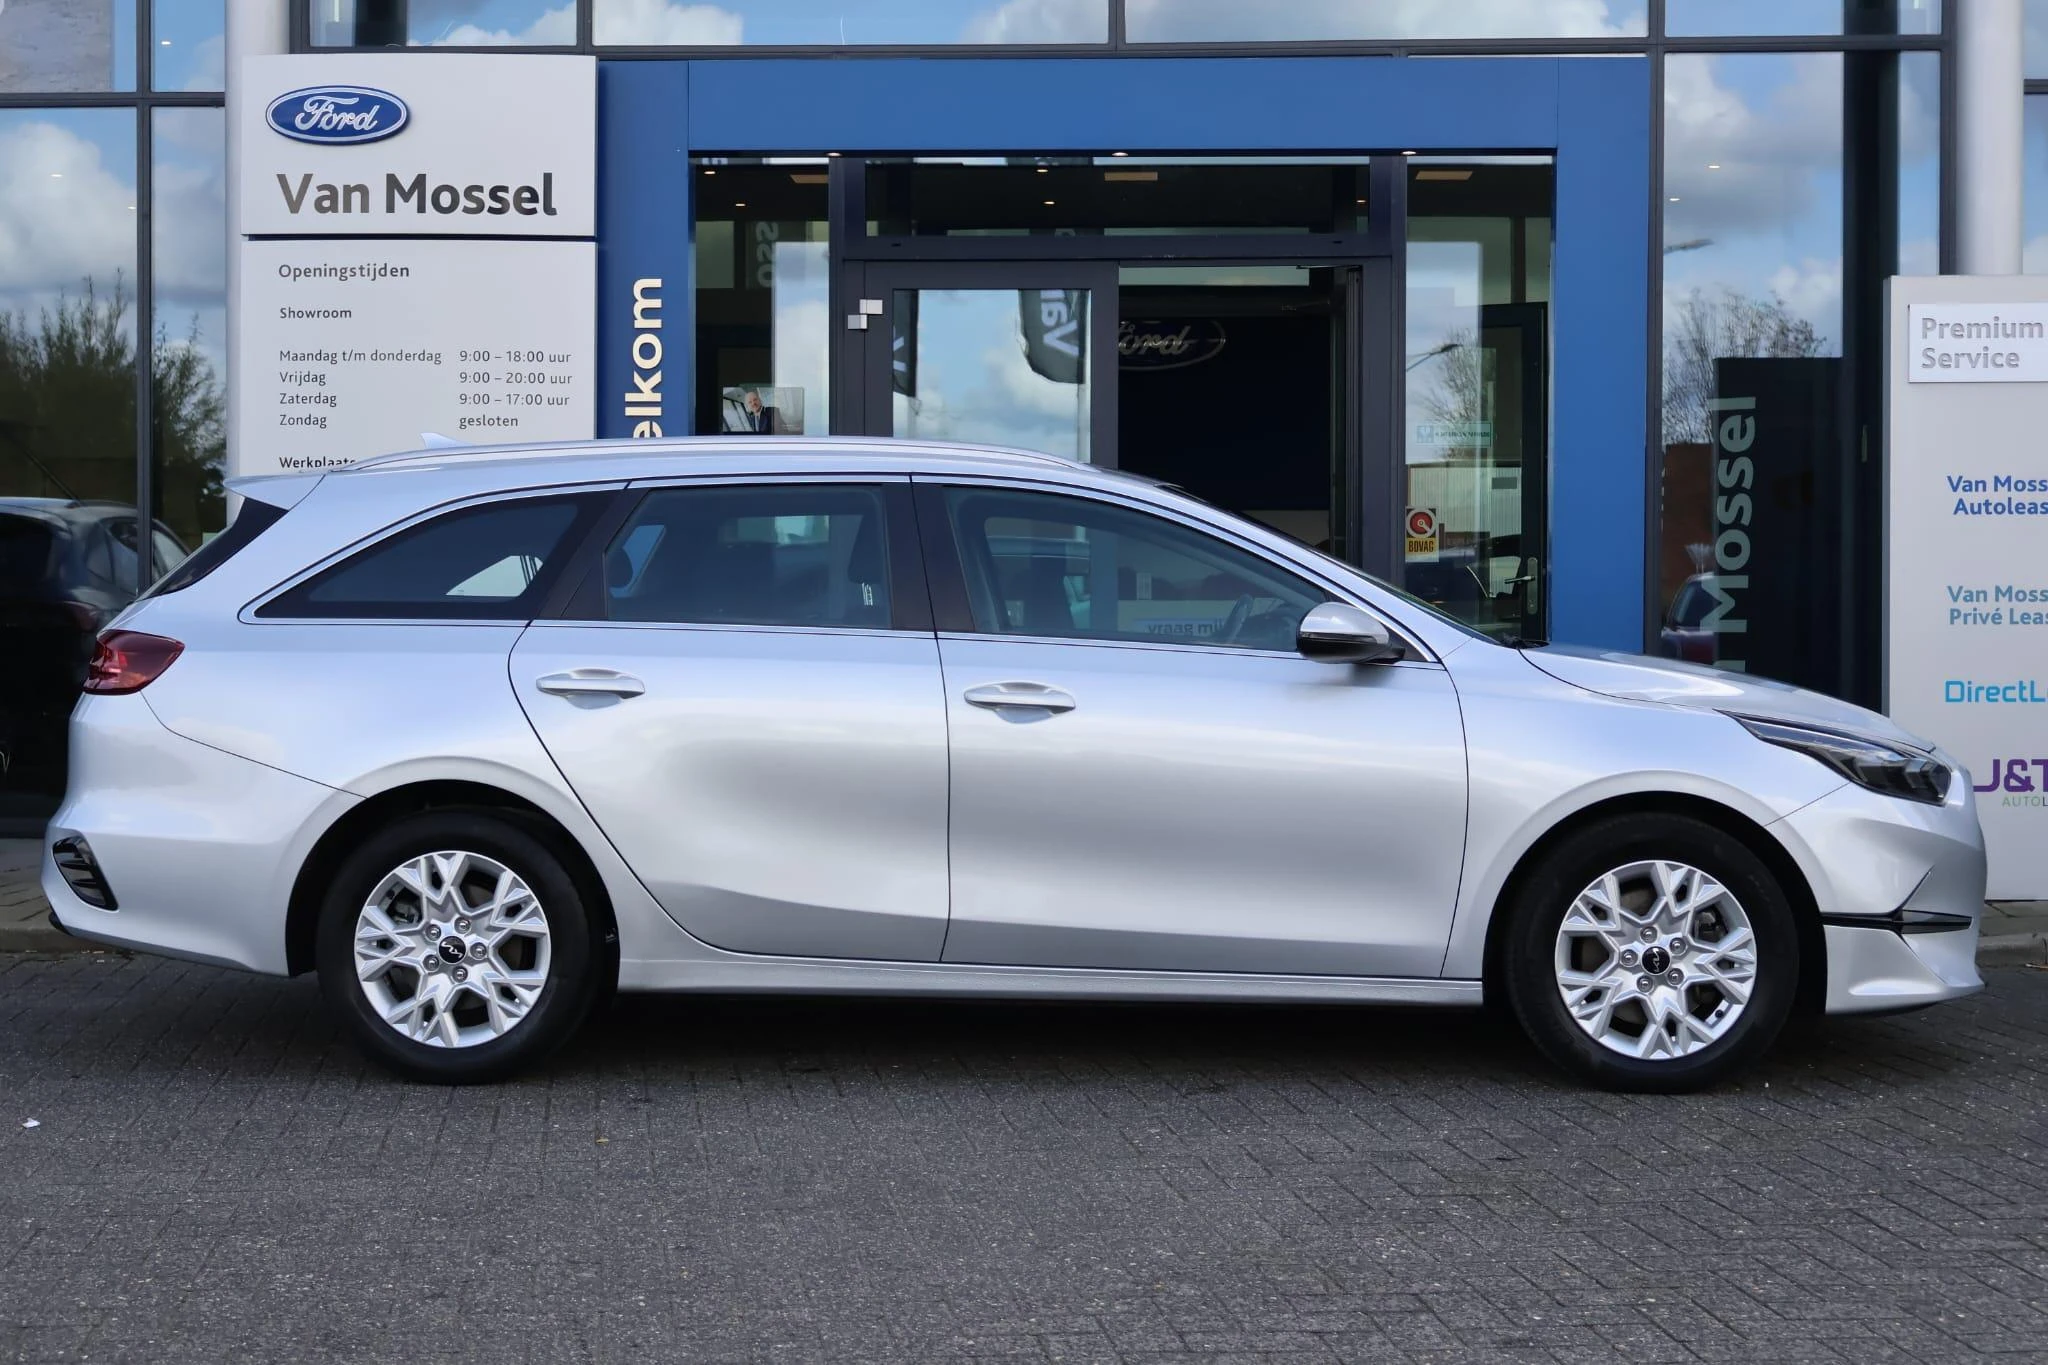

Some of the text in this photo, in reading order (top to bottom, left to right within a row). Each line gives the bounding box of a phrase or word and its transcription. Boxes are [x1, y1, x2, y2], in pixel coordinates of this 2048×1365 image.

[295, 95, 380, 131] Ford
[276, 172, 558, 216] Van Mossel
[278, 263, 410, 282] Openingstijden
[279, 306, 352, 319] Showroom
[1922, 316, 2044, 339] Premium
[279, 349, 338, 365] Maandag
[342, 349, 366, 362] t/m
[370, 349, 442, 365] donderdag
[459, 350, 490, 362] 9:00
[506, 350, 545, 362] 18:00
[549, 353, 572, 363] uur
[1922, 346, 2020, 369] Service
[279, 371, 326, 387] Vrijdag
[459, 372, 490, 384] 9:00
[506, 372, 546, 384] 20:00
[550, 375, 573, 384] uur
[279, 392, 337, 407] Zaterdag
[459, 393, 490, 405] 9:00
[506, 393, 543, 405] 17:00
[547, 396, 571, 406] uur
[279, 414, 519, 430] Zondag gesloten
[1947, 475, 2048, 492] Van Moss
[1700, 395, 1757, 633] Mossel
[1408, 540, 1434, 553] BOVAG
[1947, 585, 1988, 602] Van
[1950, 607, 2048, 625] Privé Lea
[1945, 679, 2048, 703] DirectL
